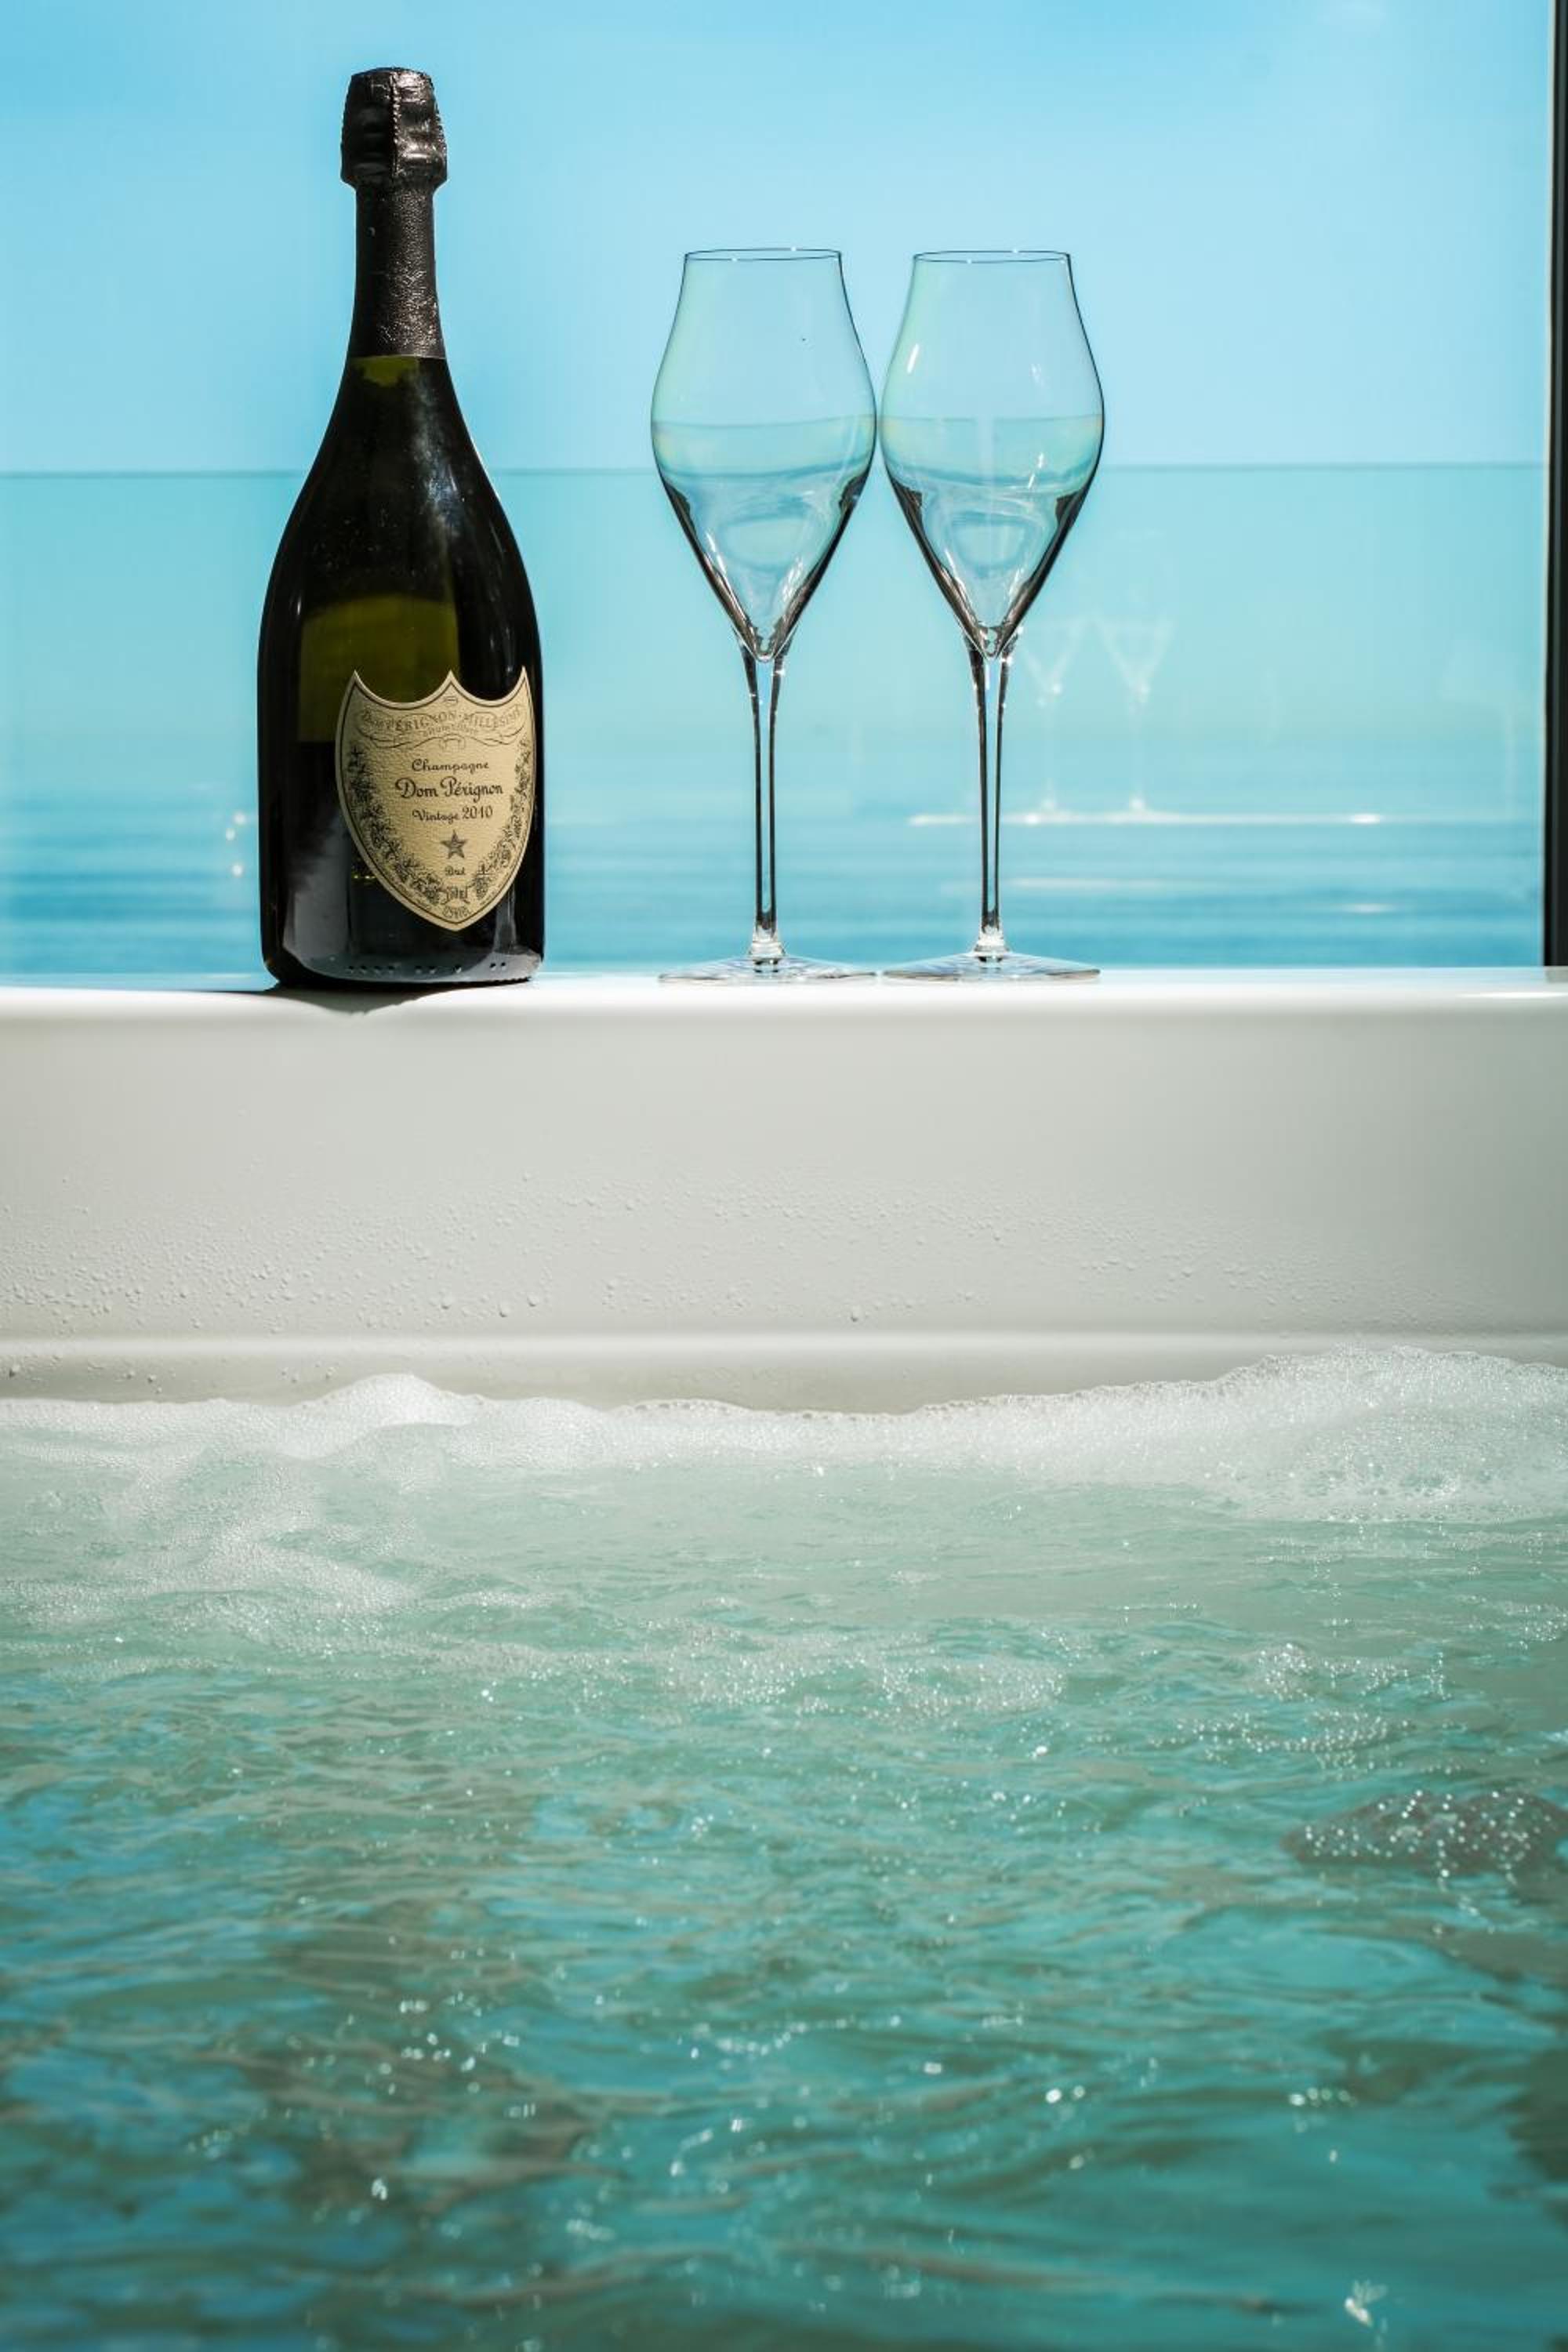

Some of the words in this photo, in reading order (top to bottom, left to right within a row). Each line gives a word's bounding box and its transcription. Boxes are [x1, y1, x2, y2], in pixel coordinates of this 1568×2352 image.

[412, 758, 490, 775] Champagne
[395, 777, 438, 798] Dom
[440, 775, 503, 803] Pérignon
[412, 809, 461, 824] Vintage
[462, 805, 493, 819] 2010
